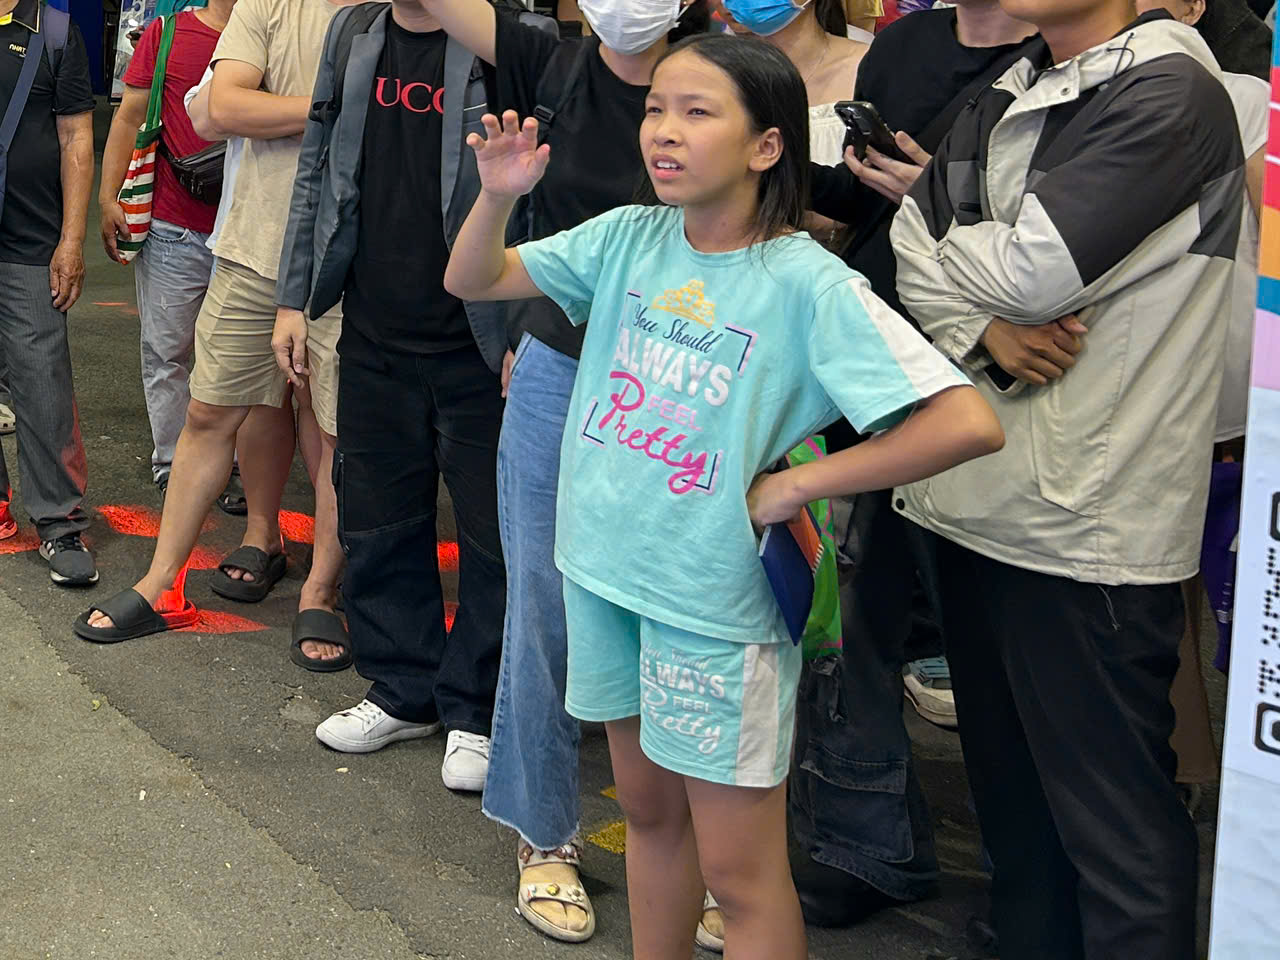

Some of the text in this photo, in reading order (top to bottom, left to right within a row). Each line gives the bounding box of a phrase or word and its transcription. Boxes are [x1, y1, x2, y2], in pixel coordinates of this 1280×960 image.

[632, 303, 724, 353] You Should
[612, 328, 732, 407] ALWAYS
[598, 370, 708, 494] Pretty
[647, 393, 703, 432] FEEL
[673, 695, 713, 714] FEEL
